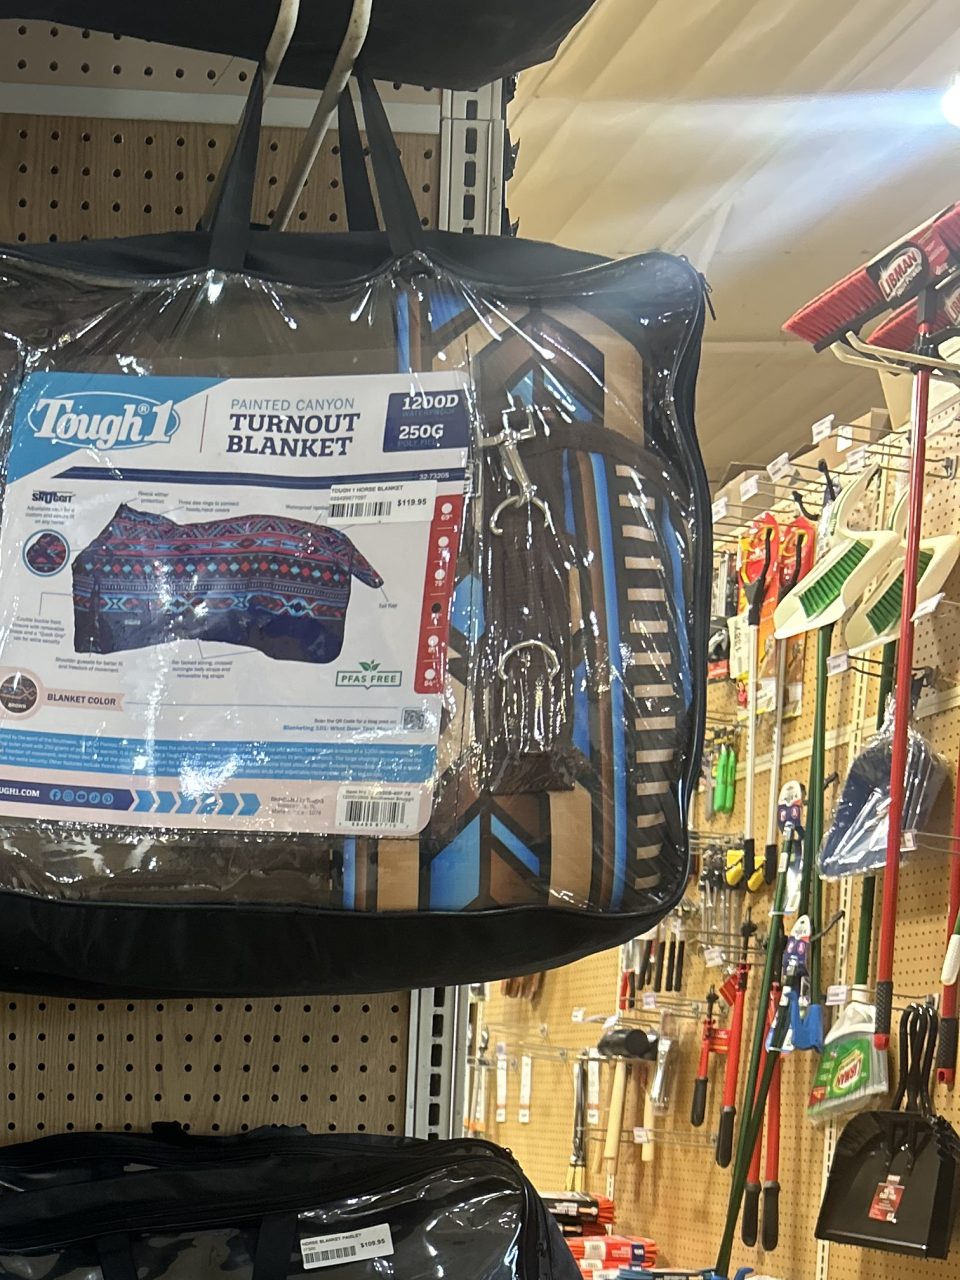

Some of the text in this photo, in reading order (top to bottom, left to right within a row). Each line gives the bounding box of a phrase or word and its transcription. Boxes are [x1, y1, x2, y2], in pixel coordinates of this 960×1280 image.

[879, 250, 919, 299] LIBMAN
[231, 398, 355, 411] PAINTED CANYON
[402, 394, 459, 411] 1200D
[230, 412, 361, 435] TURNOUT
[398, 424, 444, 440] 250G
[226, 434, 353, 458] BLANKET
[397, 498, 427, 507] $119.95
[341, 674, 397, 684] PFAS FREE
[47, 693, 117, 706] BLANKET COLOR
